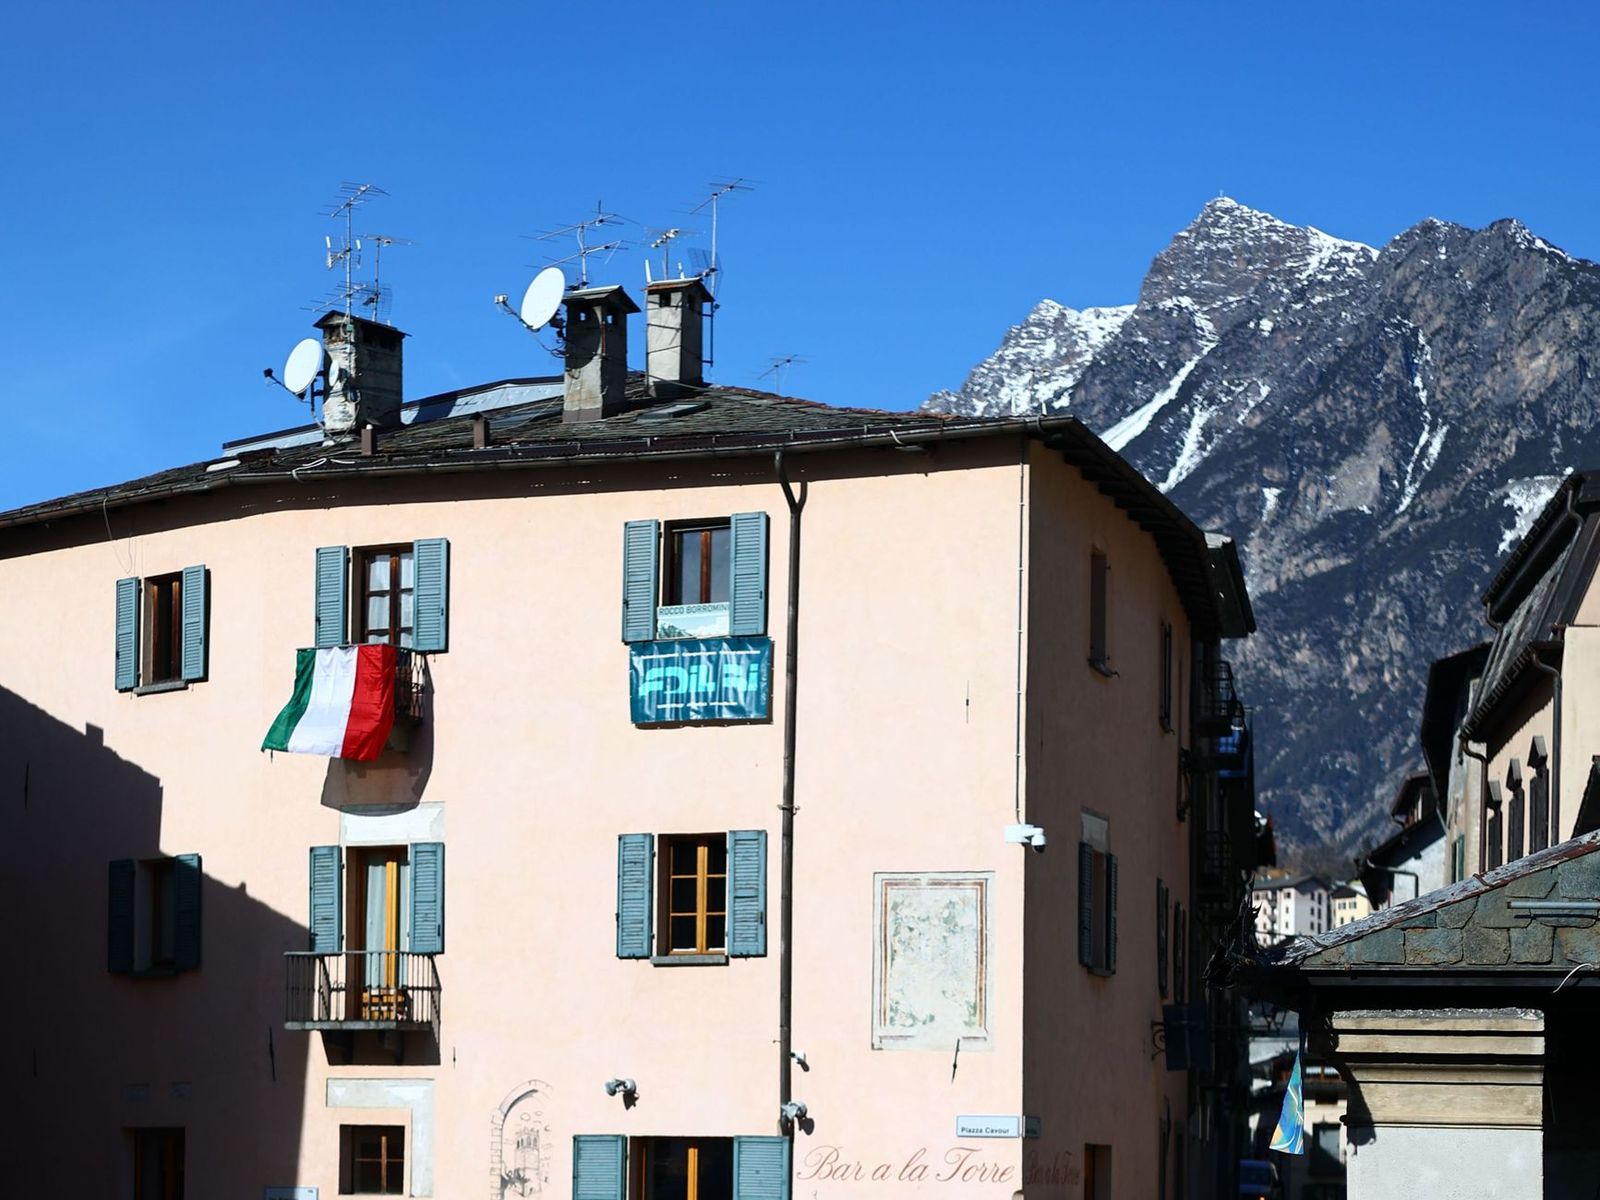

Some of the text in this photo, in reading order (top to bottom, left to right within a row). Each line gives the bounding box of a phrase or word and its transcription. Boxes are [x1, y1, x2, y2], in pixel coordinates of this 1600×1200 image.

[659, 606, 684, 615] ROCCO
[961, 1126, 1010, 1134] Piazza Cavour
[796, 1145, 1015, 1184] Bar a la Torre
